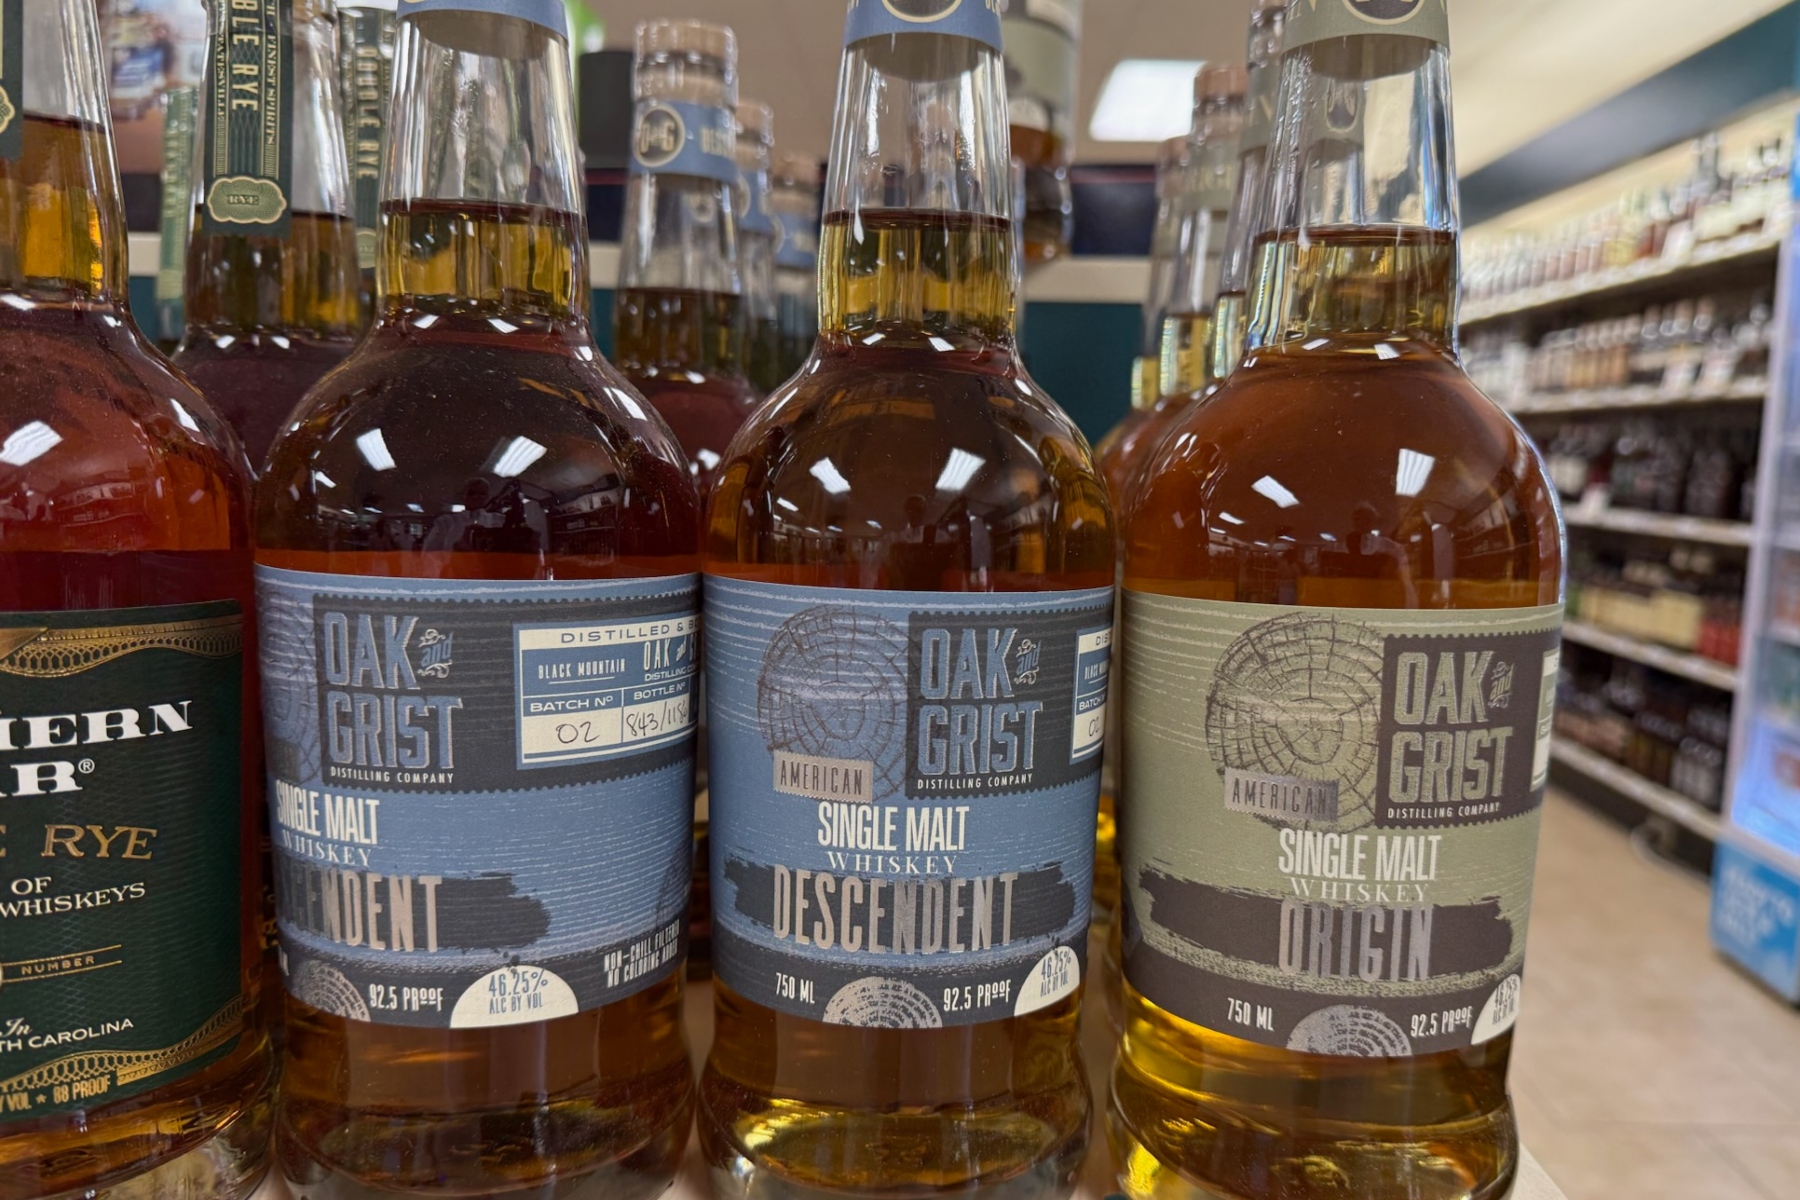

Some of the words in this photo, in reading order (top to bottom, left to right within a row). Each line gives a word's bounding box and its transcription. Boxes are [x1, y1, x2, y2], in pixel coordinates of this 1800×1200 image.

[266, 35, 277, 86] FINEST
[231, 64, 259, 111] RYE
[266, 88, 277, 145] SPIRITS
[227, 195, 259, 205] RYE
[561, 624, 670, 644] DISTILLED
[676, 622, 684, 632] &
[323, 611, 420, 690] OAK
[420, 631, 454, 668] and
[643, 638, 671, 671] OAK
[920, 627, 1018, 700] OAK
[1015, 640, 1042, 676] and
[538, 662, 572, 680] BLACK
[578, 658, 626, 678] MOUNTAIN
[644, 667, 687, 682] DISTILLING
[633, 685, 675, 701] BOTTLE
[1393, 650, 1495, 725] OAK
[1489, 663, 1515, 701] and
[530, 698, 590, 713] BATCH
[327, 690, 464, 769] GRIST
[555, 721, 600, 744] 02
[917, 701, 1044, 776] GRIST
[330, 766, 391, 782] DISTILLING
[397, 772, 454, 784] COMPANY
[780, 759, 863, 796] AMERICAN
[1388, 726, 1514, 804] GRIST
[917, 777, 982, 790] DISTILLING
[987, 773, 1033, 788] COMPANY
[1232, 777, 1327, 815] AMERICAN
[275, 779, 322, 837] SINGLE
[324, 793, 380, 845] MALT
[1387, 807, 1453, 819] DISTILLING
[1458, 802, 1501, 817] COMPANY
[40, 823, 158, 860] RYE
[817, 801, 899, 851] SINGLE
[905, 805, 970, 852] MALT
[282, 829, 373, 868] WHISKEY
[827, 850, 961, 875] WHISKEY
[1278, 828, 1368, 881] SINGLE
[1374, 834, 1442, 882] MALT
[11, 876, 52, 896] OF
[1289, 877, 1430, 903] WHISKEY
[773, 863, 1019, 956] DESCENDENT
[1277, 898, 1434, 983] ORIGIN
[21, 955, 95, 976] NUMBER
[607, 967, 620, 989] NO
[369, 982, 398, 1011] 92.5
[488, 968, 549, 998] 46.25%
[775, 972, 795, 999] 750
[799, 979, 816, 1005] ML
[489, 997, 507, 1015] ALC
[511, 994, 523, 1013] BY
[527, 992, 543, 1009] VOL
[943, 986, 972, 1012] 92.5
[1227, 997, 1251, 1026] 750
[1256, 1005, 1275, 1032] ML
[28, 1018, 135, 1049] CAROLINA
[1409, 1012, 1437, 1038] 92.5
[72, 1075, 111, 1101] PROOF
